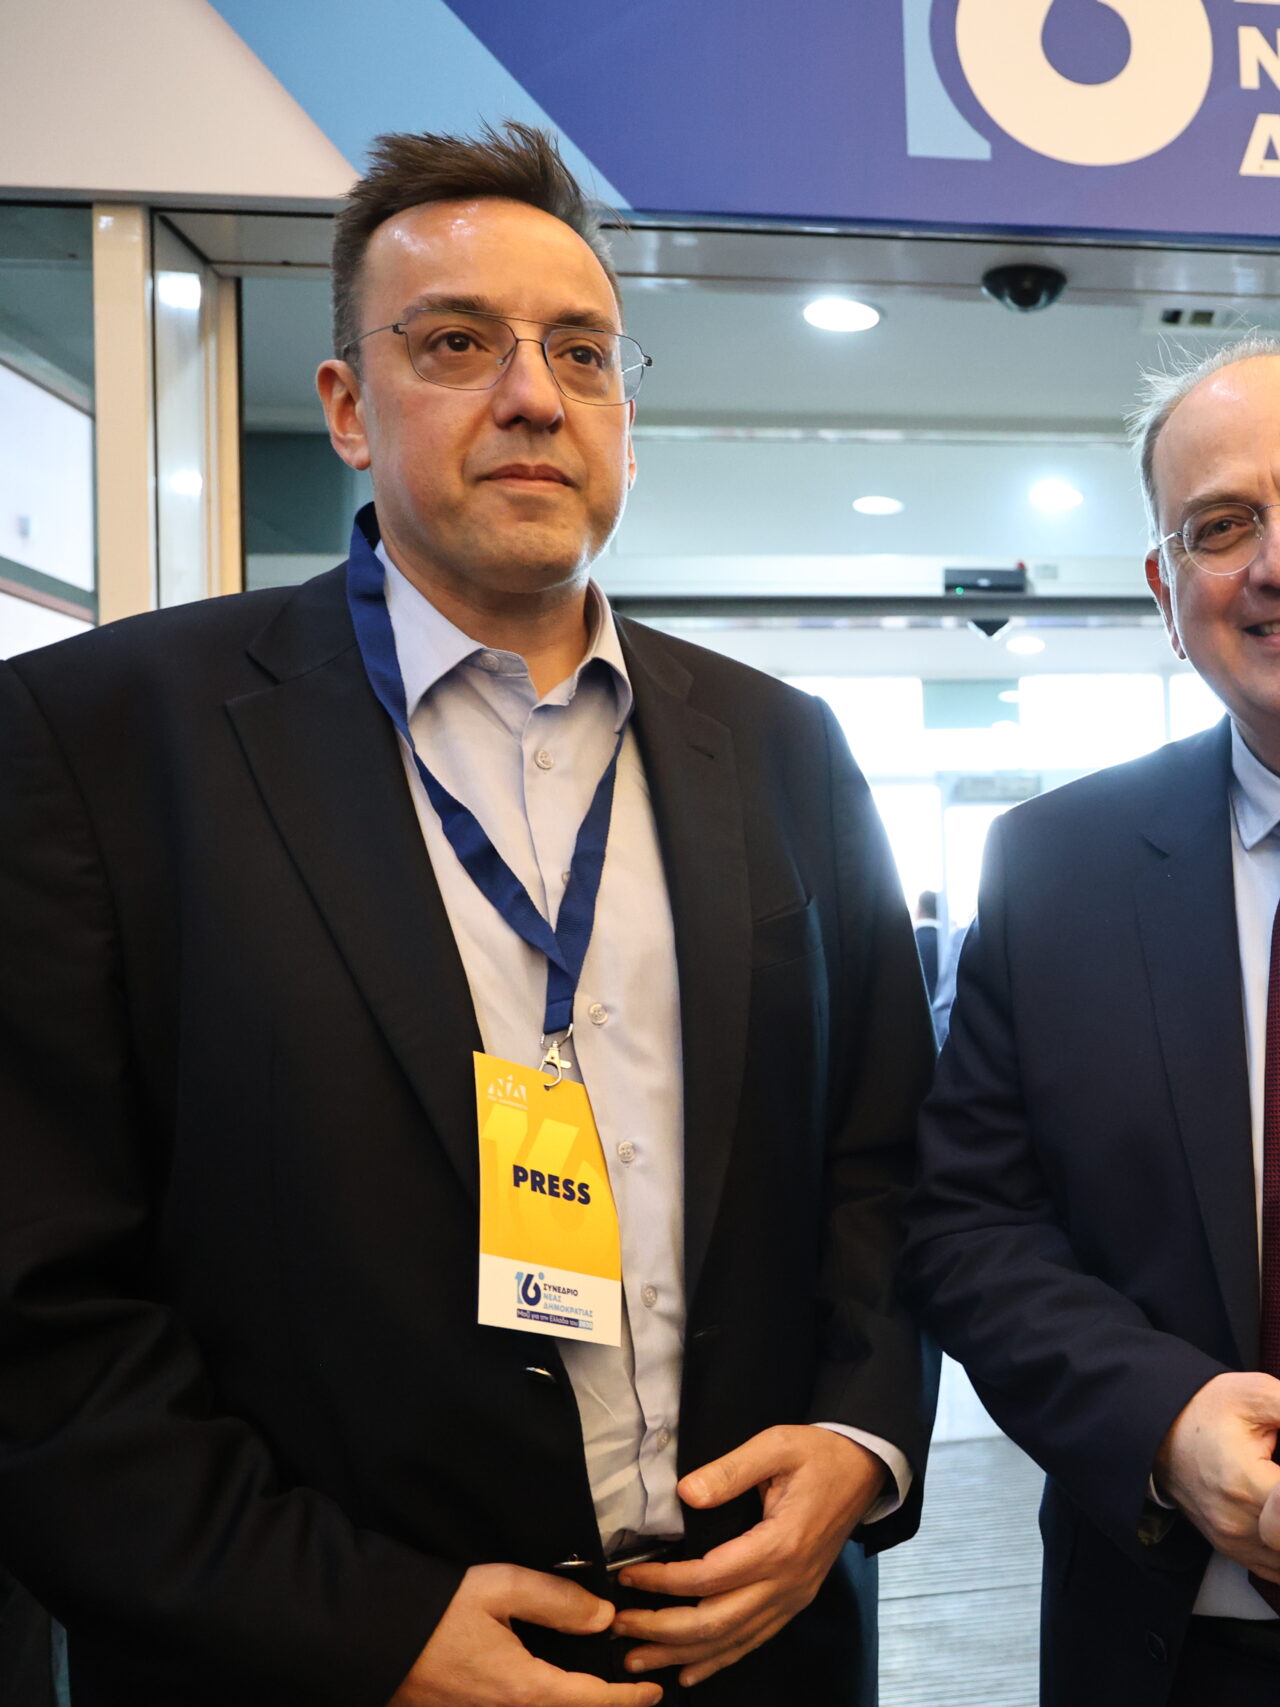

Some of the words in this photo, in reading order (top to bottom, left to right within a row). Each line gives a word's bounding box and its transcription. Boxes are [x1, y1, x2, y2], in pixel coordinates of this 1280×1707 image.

[513, 1164, 591, 1205] PRESS
[543, 1284, 579, 1296] ΣΥΝΕΔΡΙΟ
[543, 1293, 562, 1302] ΝΕΑΣ
